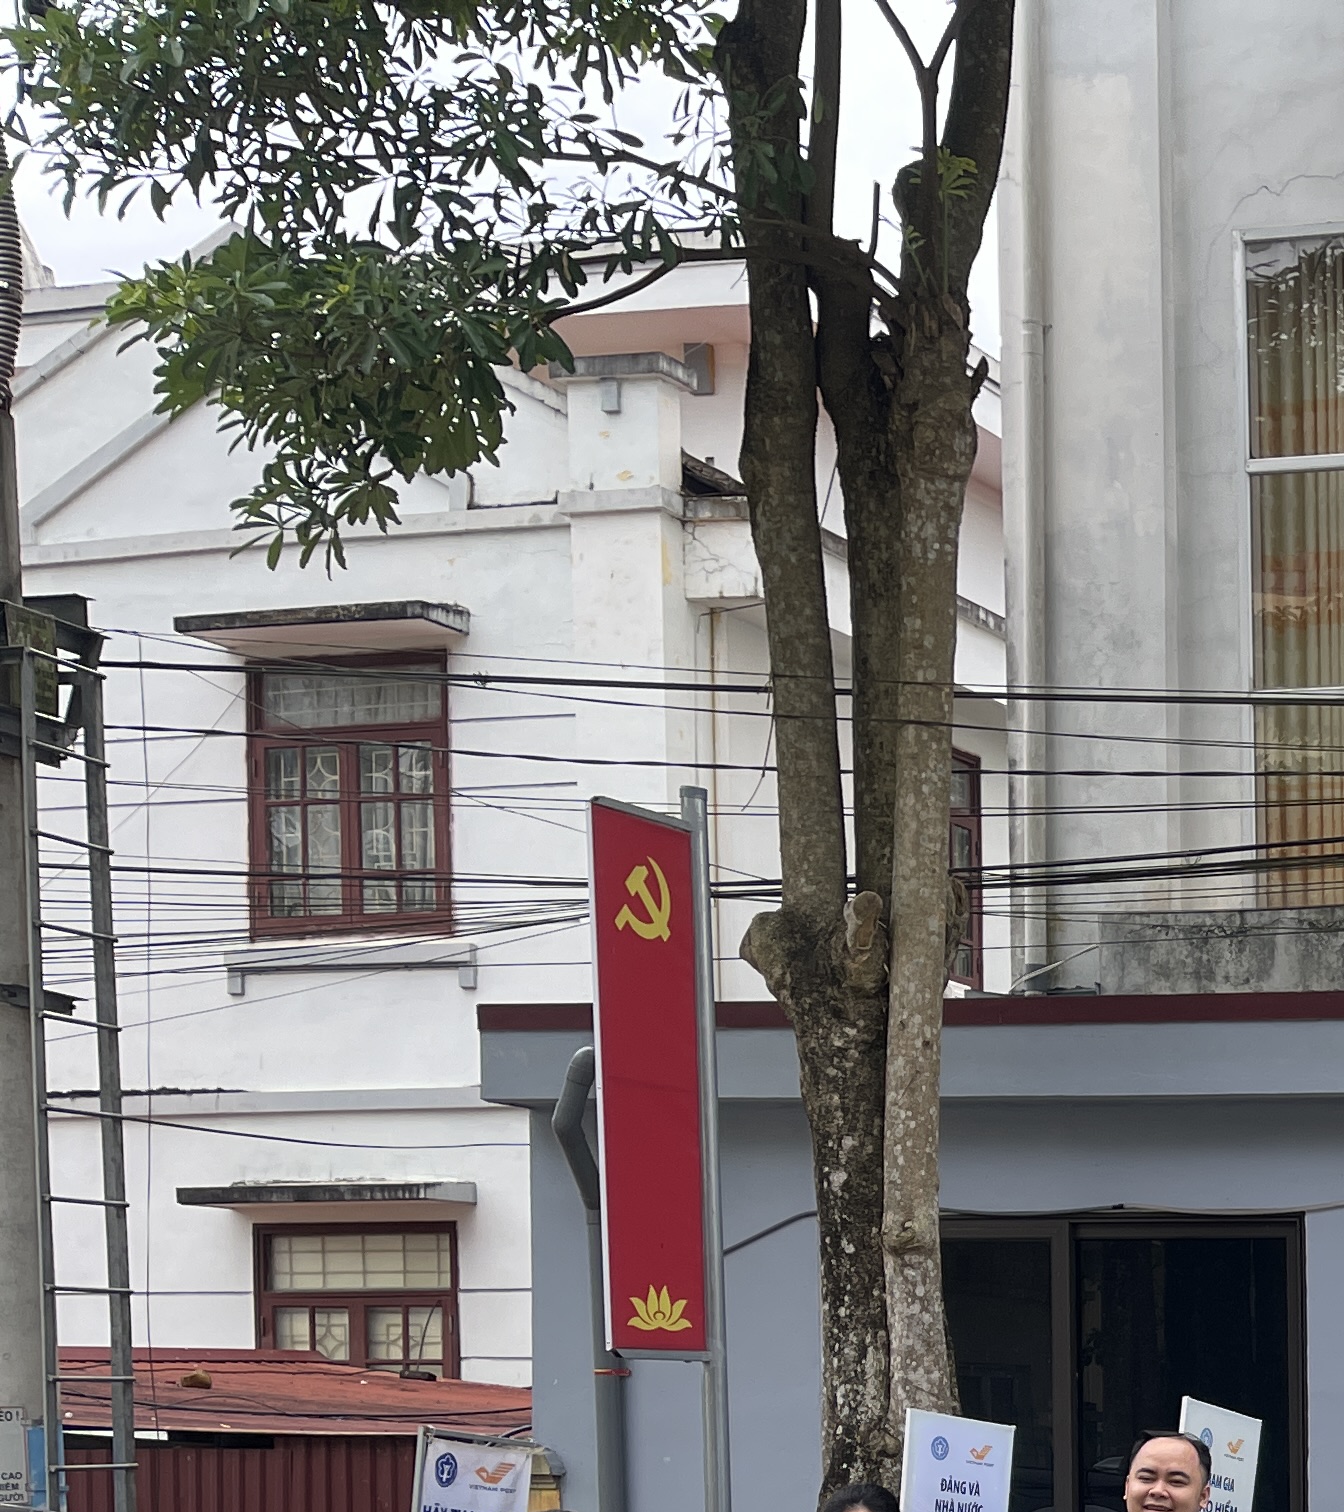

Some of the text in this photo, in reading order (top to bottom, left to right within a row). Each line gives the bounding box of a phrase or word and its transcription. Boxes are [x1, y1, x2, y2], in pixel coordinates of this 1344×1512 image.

[1, 1471, 23, 1480] CAO
[940, 1475, 981, 1497] ĐẢNG VÀ
